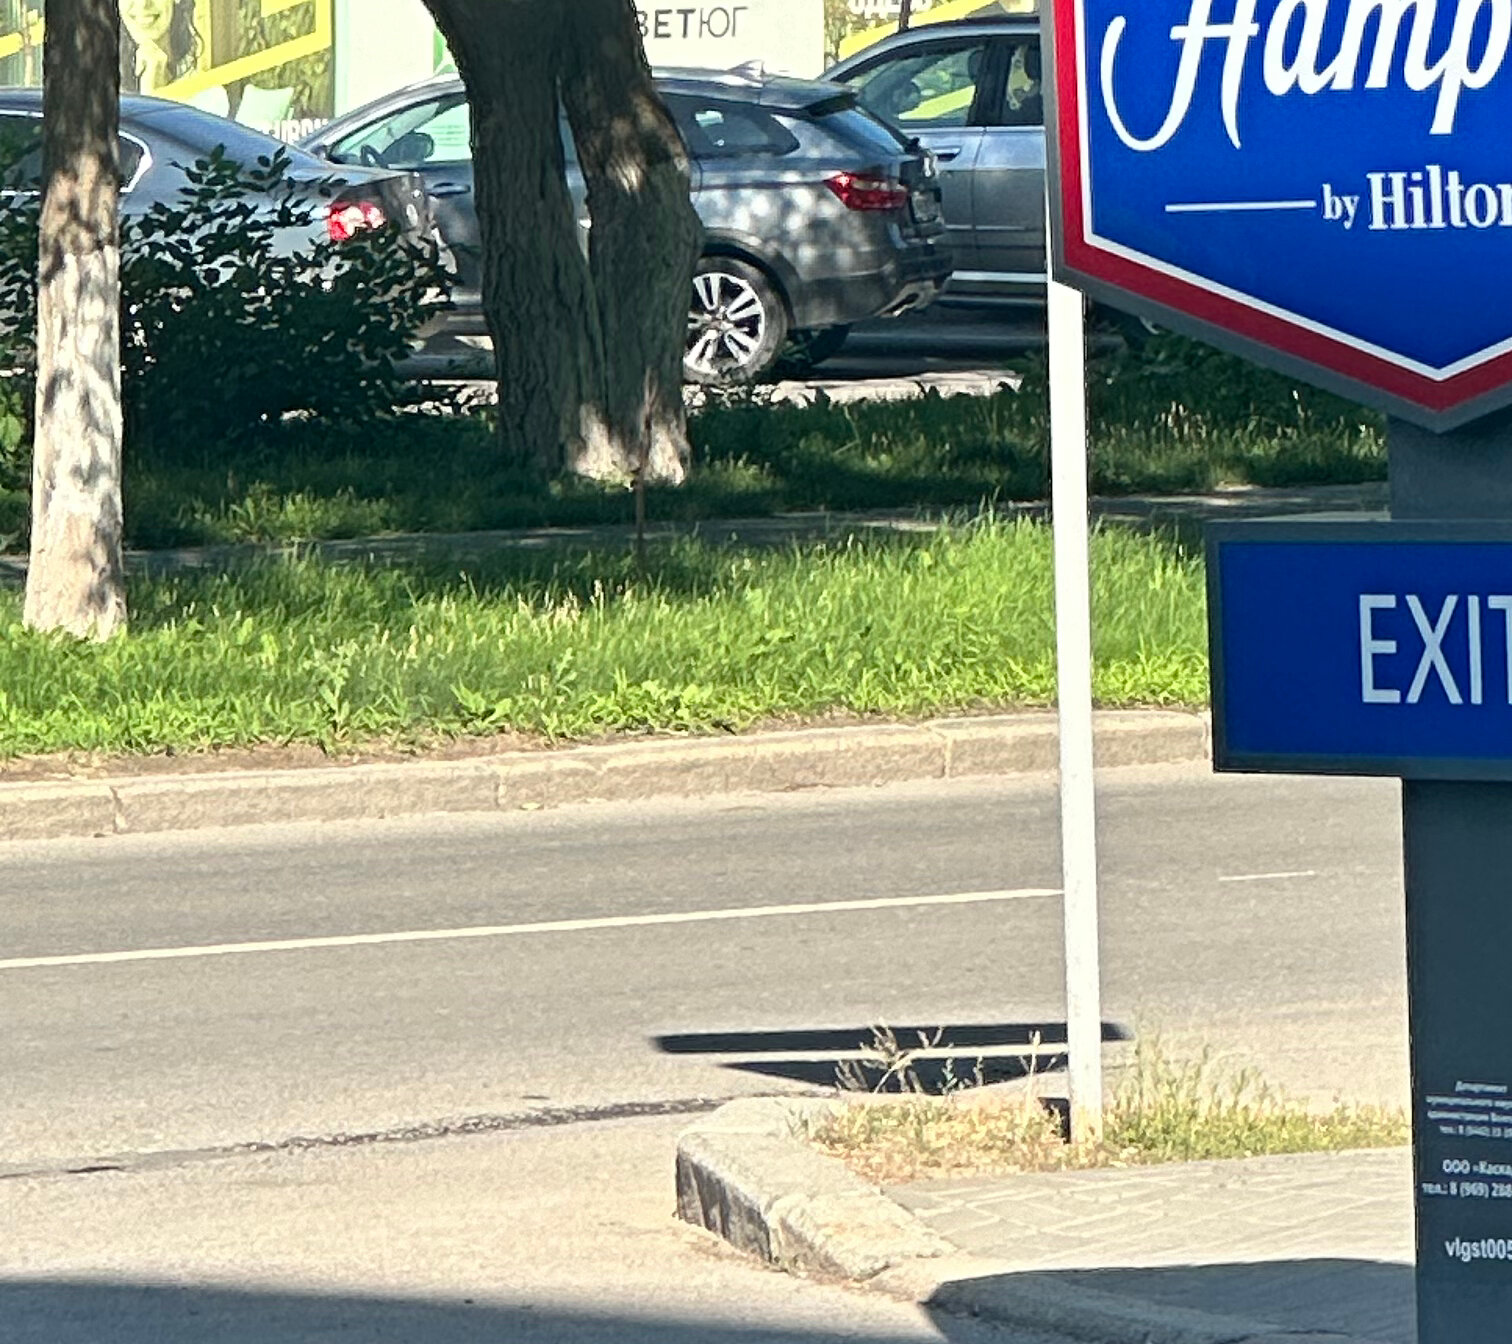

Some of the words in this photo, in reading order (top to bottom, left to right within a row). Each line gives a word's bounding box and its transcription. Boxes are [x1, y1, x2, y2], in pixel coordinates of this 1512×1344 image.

[1322, 183, 1360, 231] by
[1442, 1159, 1470, 1174] ООО
[1449, 1180, 1458, 1195] 8
